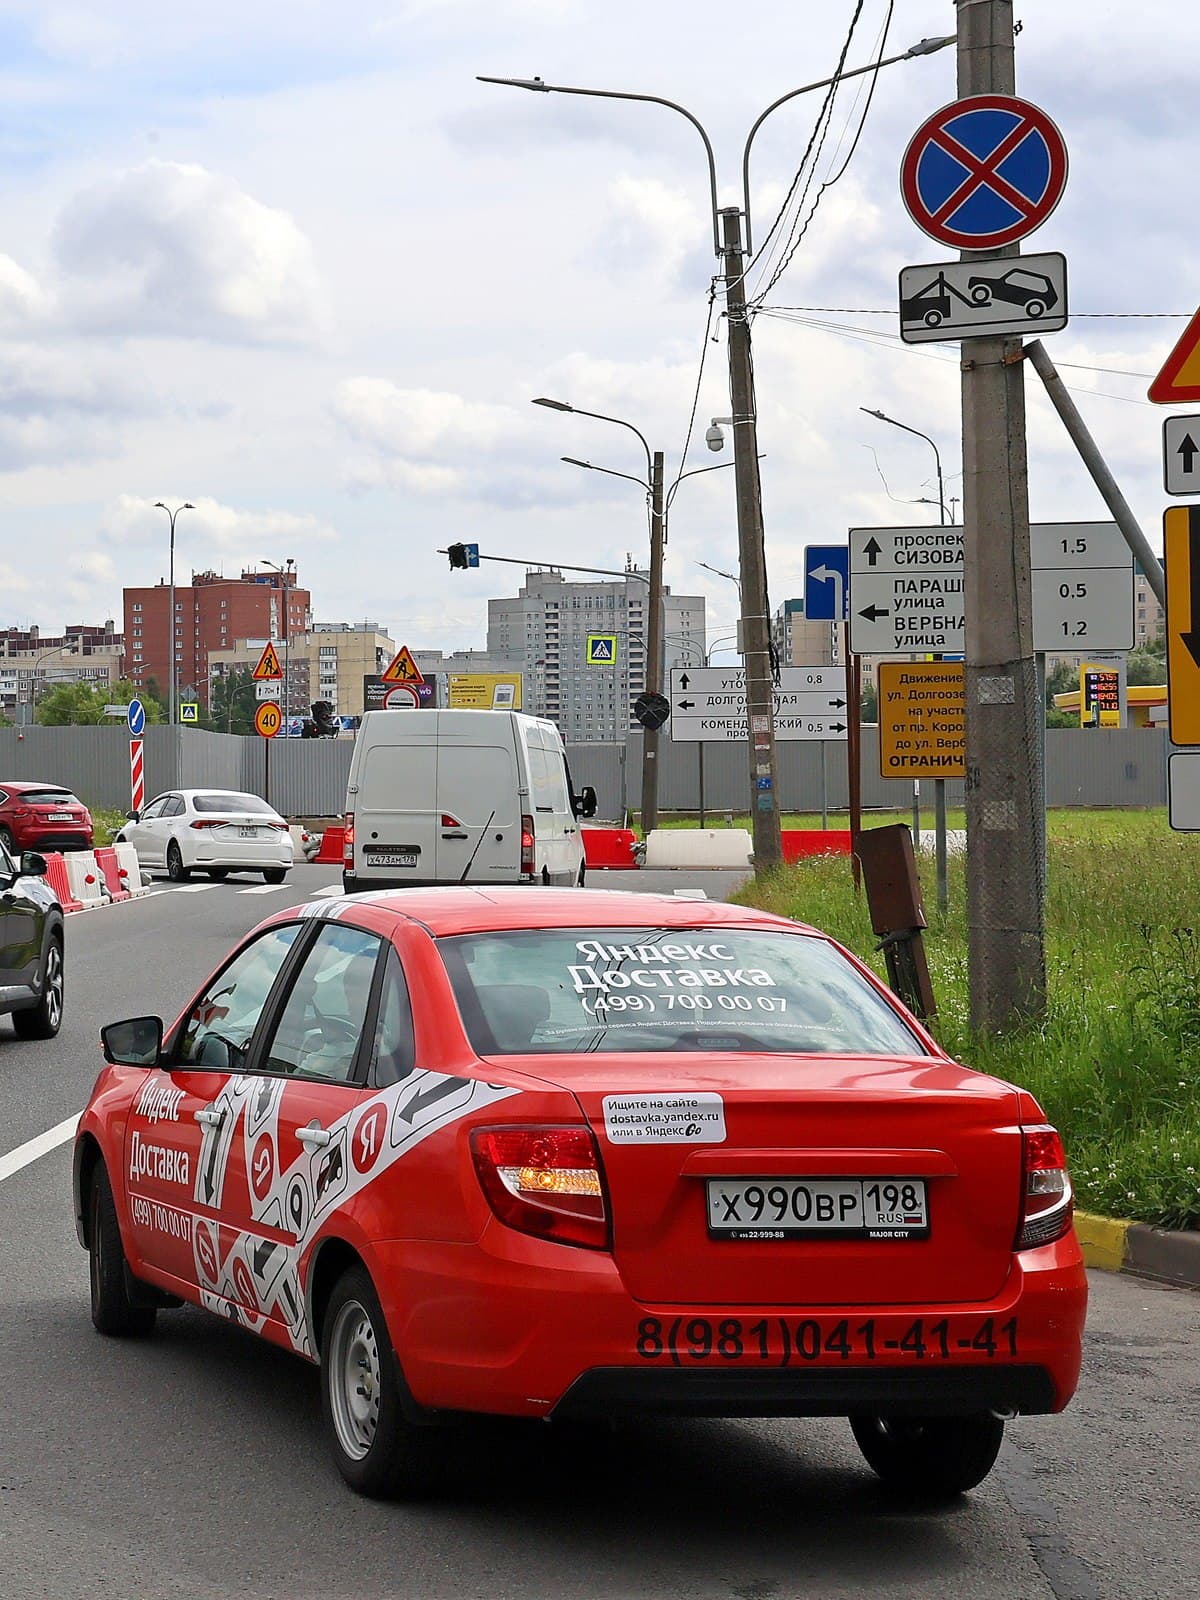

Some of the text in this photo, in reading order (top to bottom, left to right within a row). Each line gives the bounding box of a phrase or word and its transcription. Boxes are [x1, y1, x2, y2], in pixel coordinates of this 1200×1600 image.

[1061, 538, 1087, 554] 1.5
[894, 549, 965, 564] СИЗОВА
[894, 579, 1087, 599] ПАРАШ 0.5
[893, 597, 945, 612] улица
[1061, 621, 1087, 636] 1.2
[894, 634, 945, 649] улица
[806, 674, 823, 684] 0.8
[899, 673, 964, 685] Движение
[887, 691, 904, 702] ул.
[908, 707, 923, 716] на
[262, 713, 277, 727] 40
[807, 723, 823, 733] 0.5
[892, 723, 906, 732] от
[909, 723, 928, 734] пр.
[895, 740, 911, 750] до
[914, 740, 932, 751] ул.
[575, 940, 735, 965] Яндекс
[566, 965, 777, 994] Доставка
[581, 994, 788, 1016] (499) 700 00 07
[135, 1077, 188, 1125] Яндекс
[608, 1098, 698, 1111] Ищите на сайте
[610, 1111, 719, 1124] dostavka.yandex.ru
[612, 1129, 634, 1137] или
[645, 1126, 684, 1137] Яндекс
[685, 1123, 702, 1137] Go
[129, 1130, 189, 1185] Доставка
[866, 1184, 917, 1212] 198
[131, 1195, 191, 1243] (499) 700 00 07
[877, 1213, 903, 1223] RUS
[636, 1317, 1019, 1368] 8(981)041-41-41
